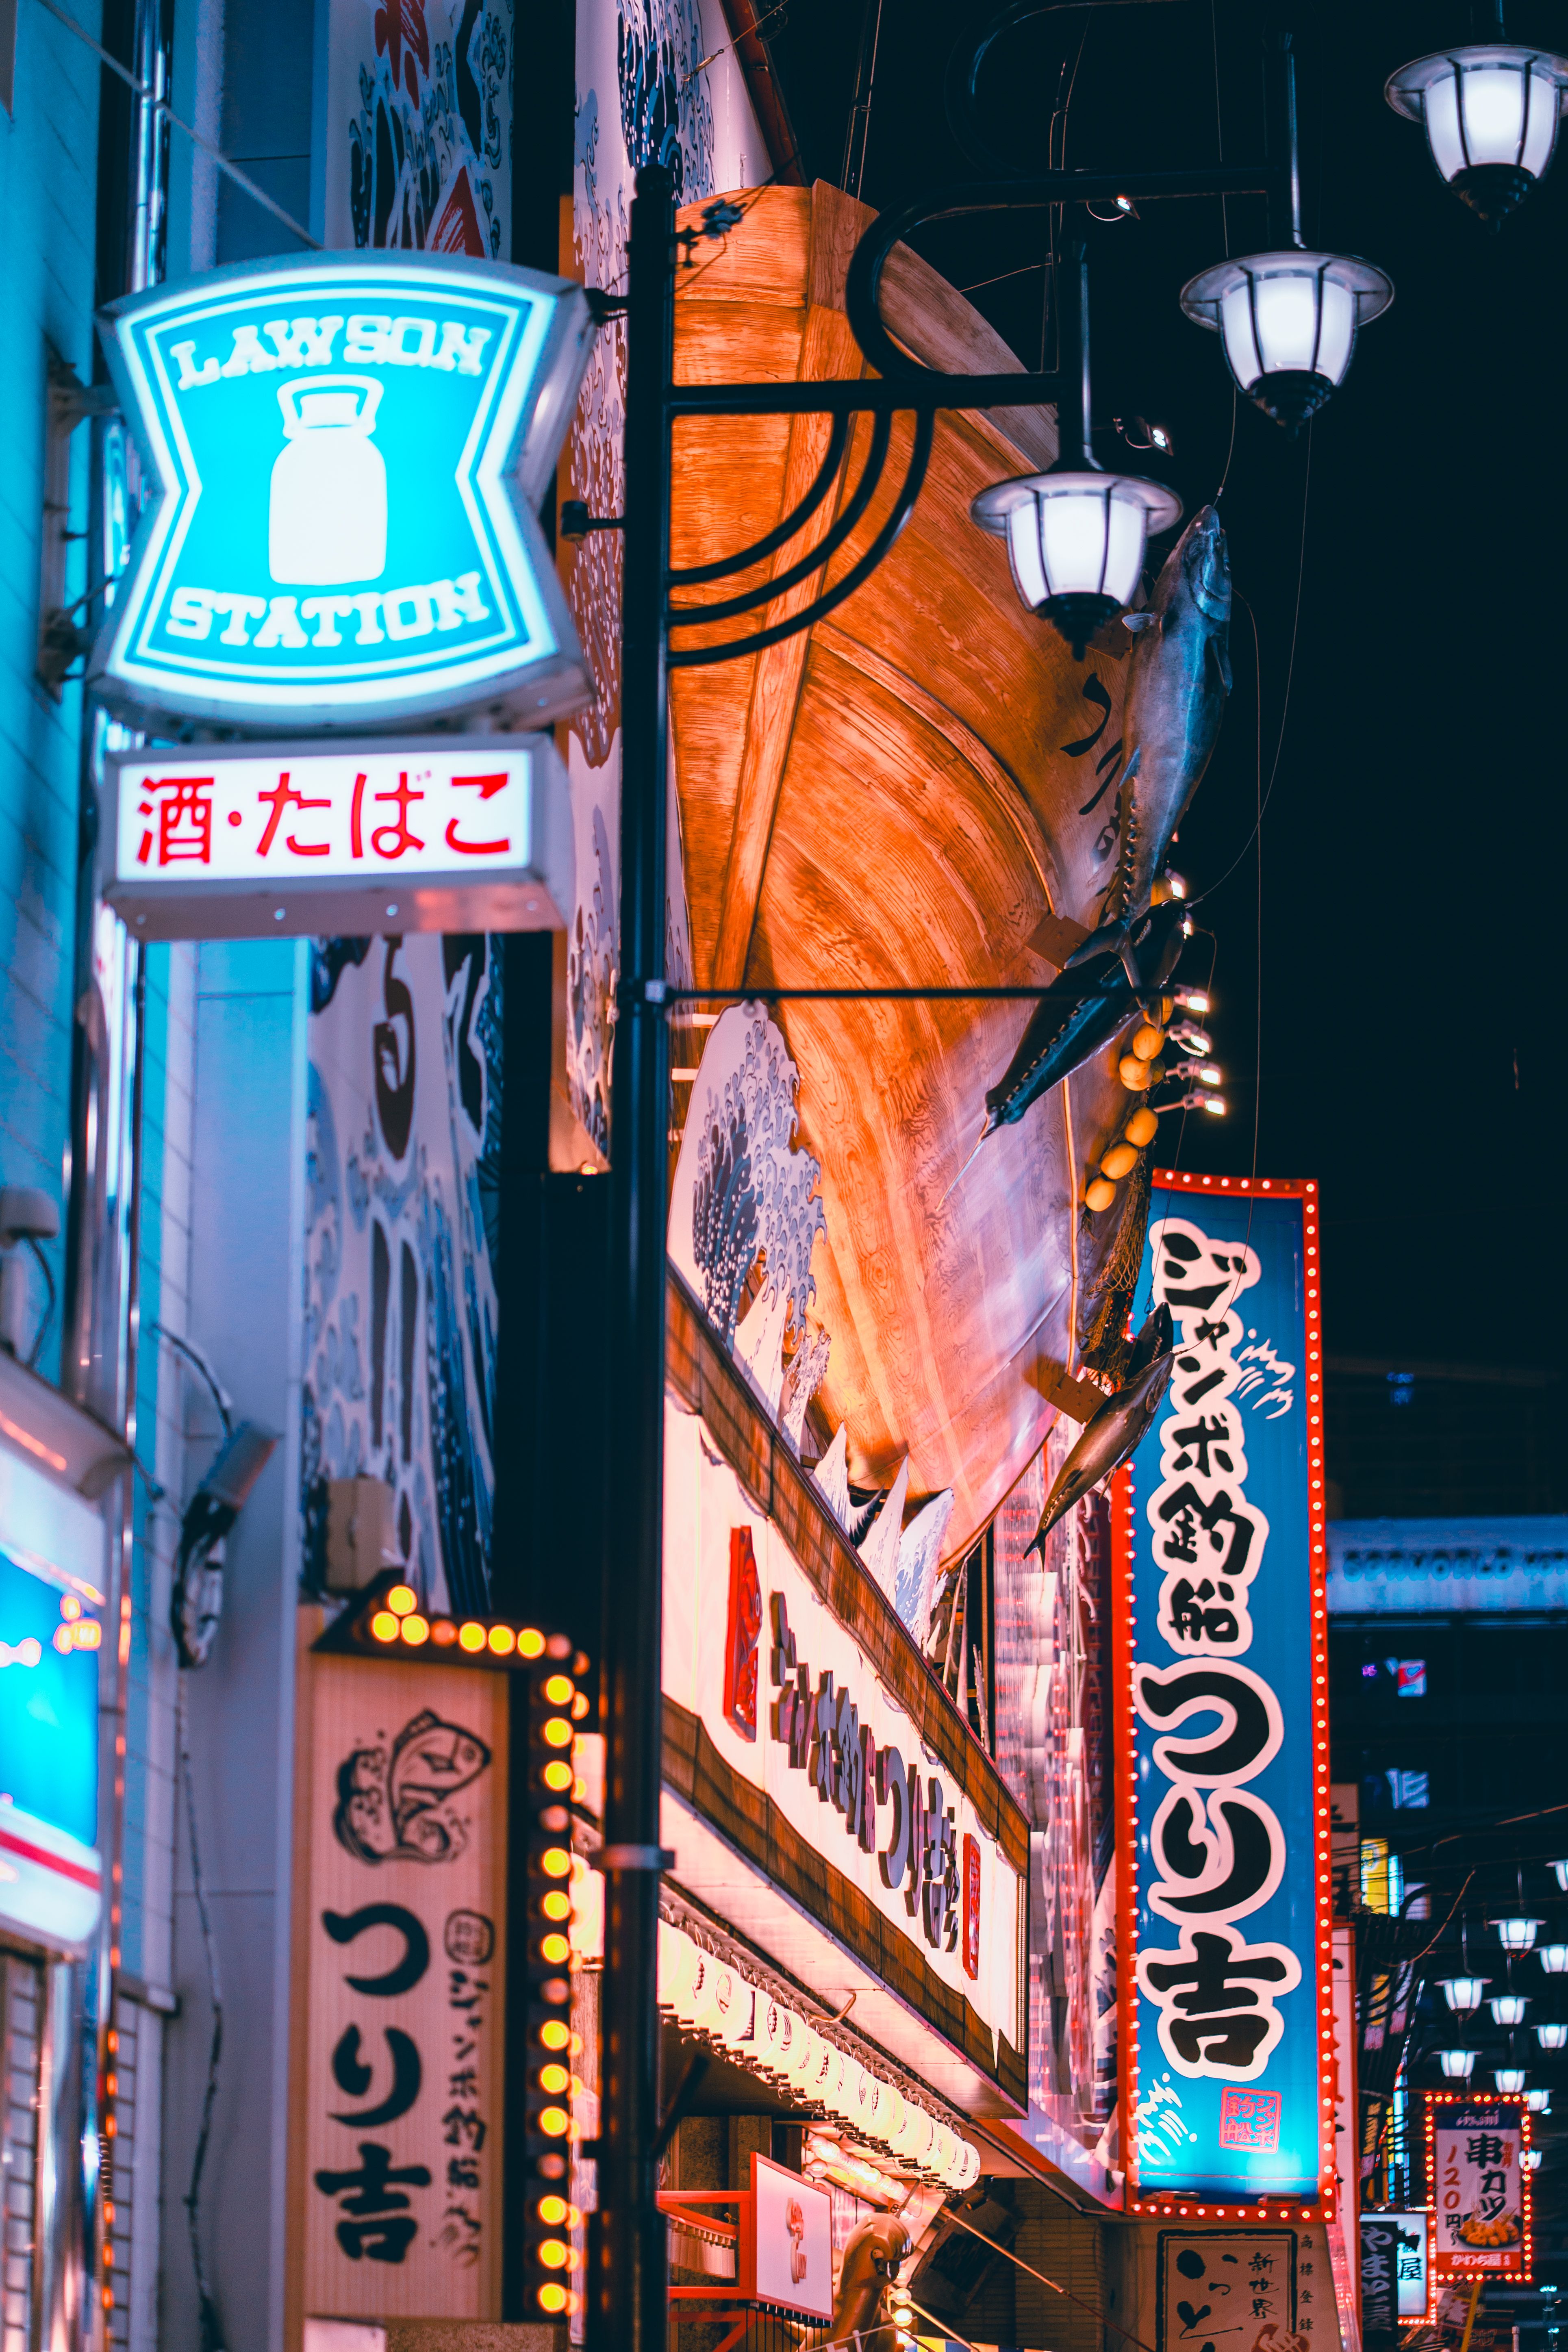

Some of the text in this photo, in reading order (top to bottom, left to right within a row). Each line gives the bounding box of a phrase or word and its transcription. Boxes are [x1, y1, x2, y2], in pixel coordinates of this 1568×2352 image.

[169, 313, 493, 392] LAWSON
[165, 571, 491, 649] STATION
[135, 769, 513, 867] 酒・たばこ
[315, 1901, 431, 2266] つり吉
[1455, 2109, 1499, 2126] Asahi
[1465, 2133, 1506, 2222] 串カツ
[1176, 2249, 1243, 2352] いっと
[1248, 2252, 1281, 2320] 新世界
